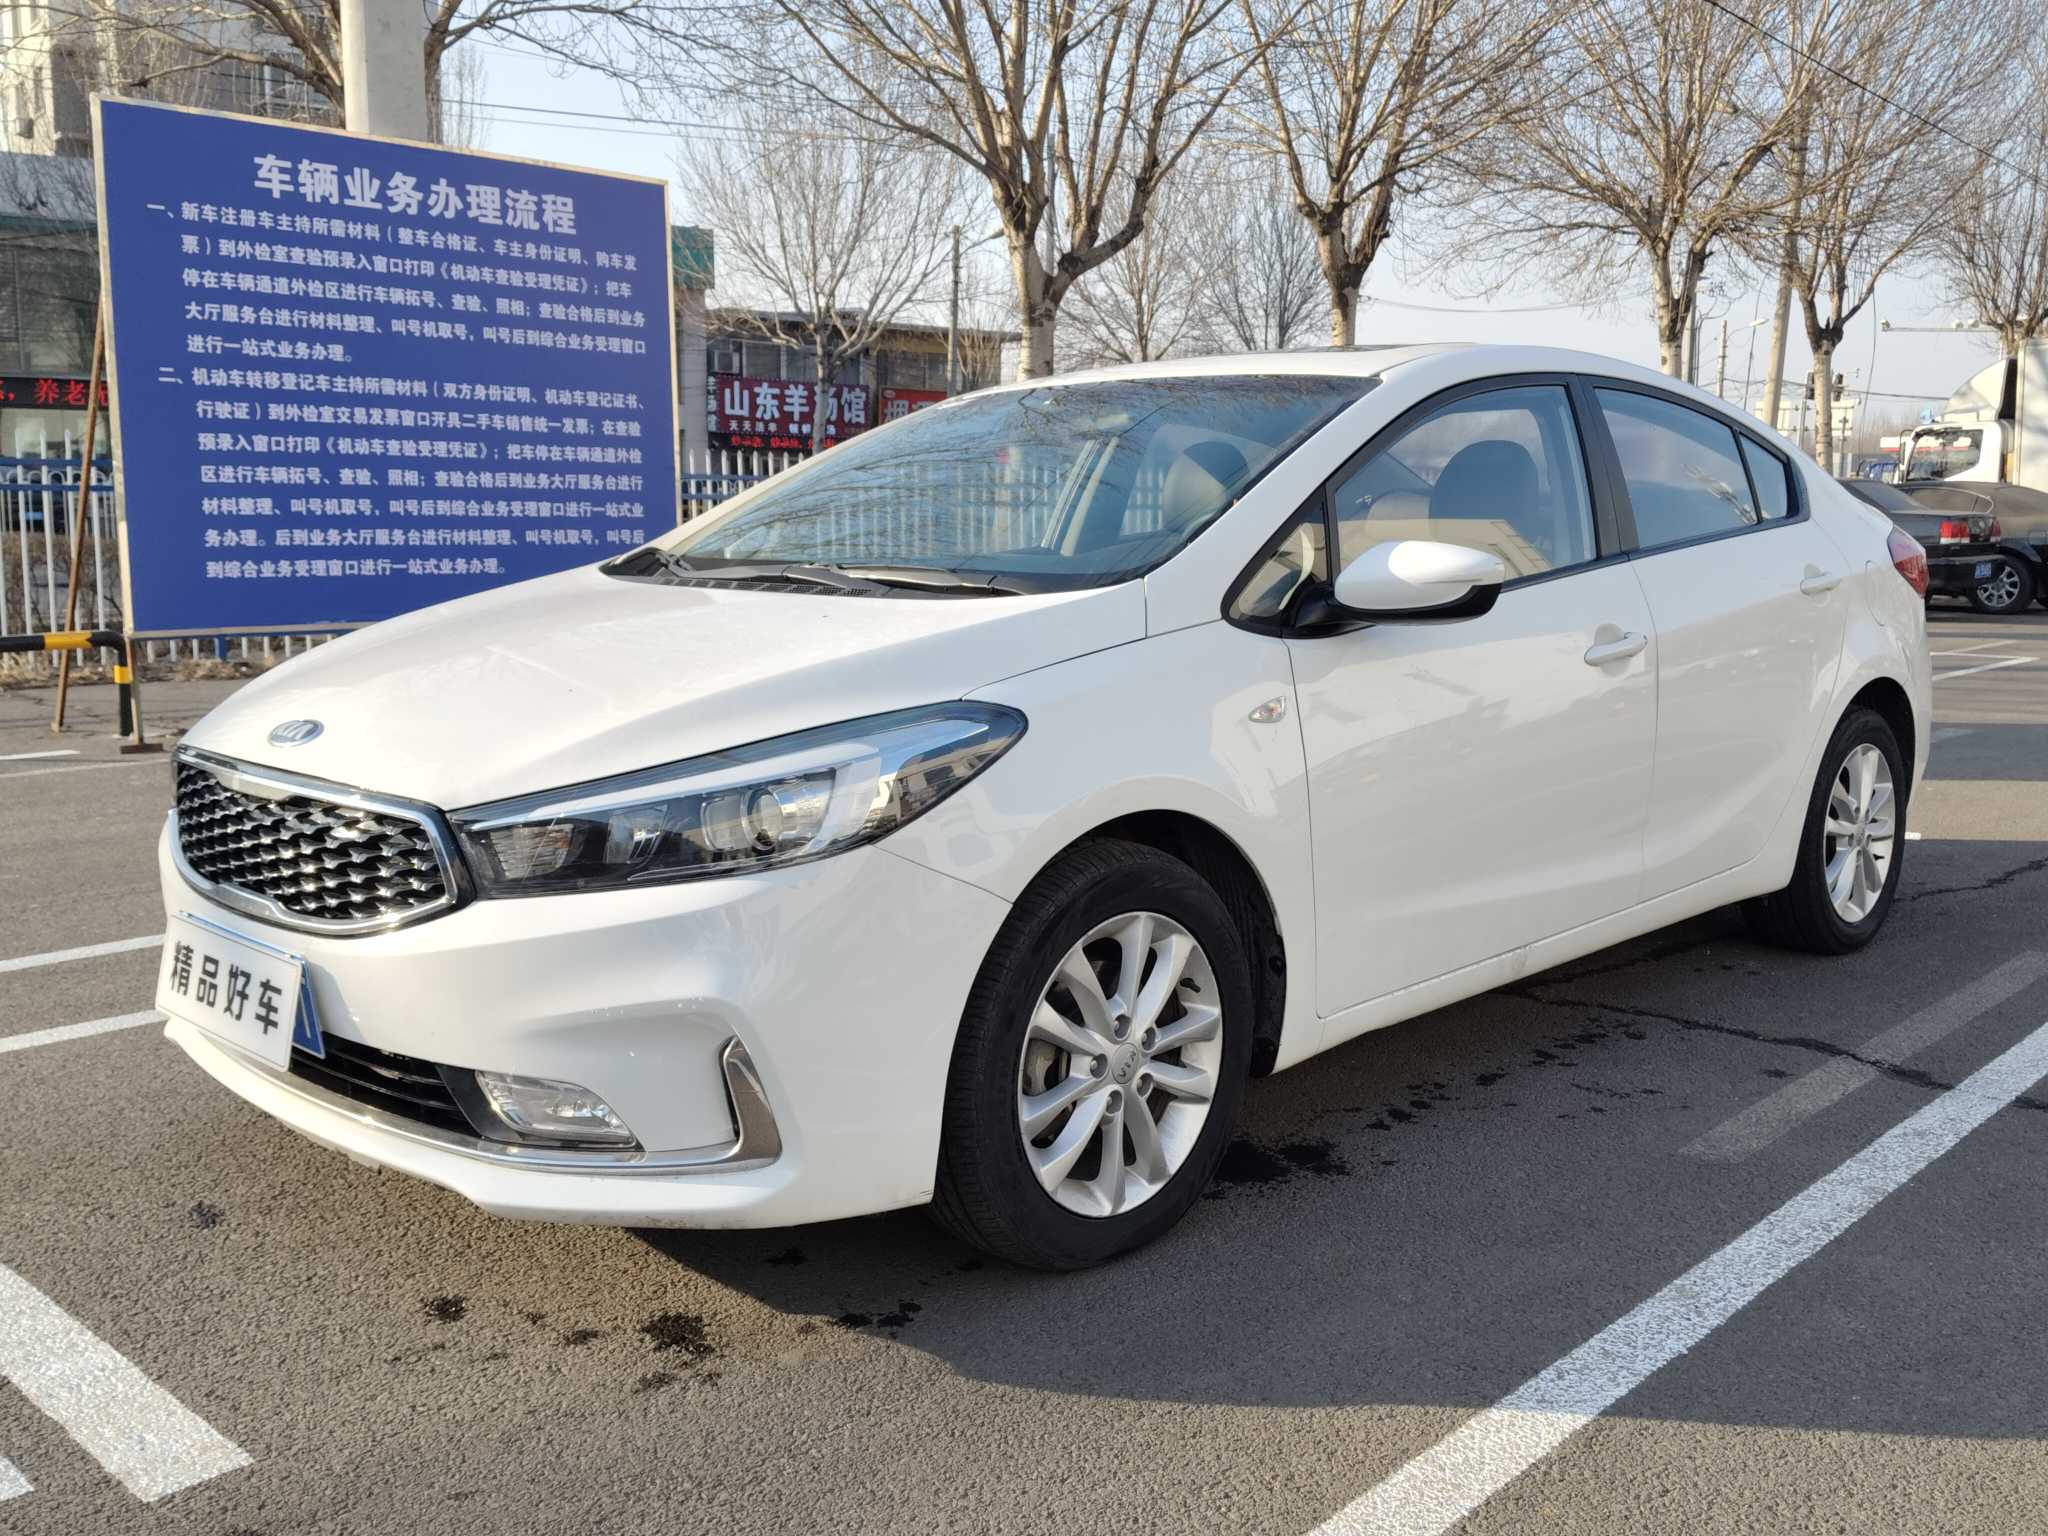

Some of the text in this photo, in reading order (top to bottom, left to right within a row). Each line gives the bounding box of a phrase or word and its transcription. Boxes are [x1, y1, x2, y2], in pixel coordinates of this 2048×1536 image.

[253, 154, 577, 235] 车辆业务办理流程
[187, 335, 353, 363] 进行一站式业务办理。
[206, 558, 505, 579] 到综合业务受理窗口进行一站式业务办理。
[170, 940, 283, 1035] 精品好车
